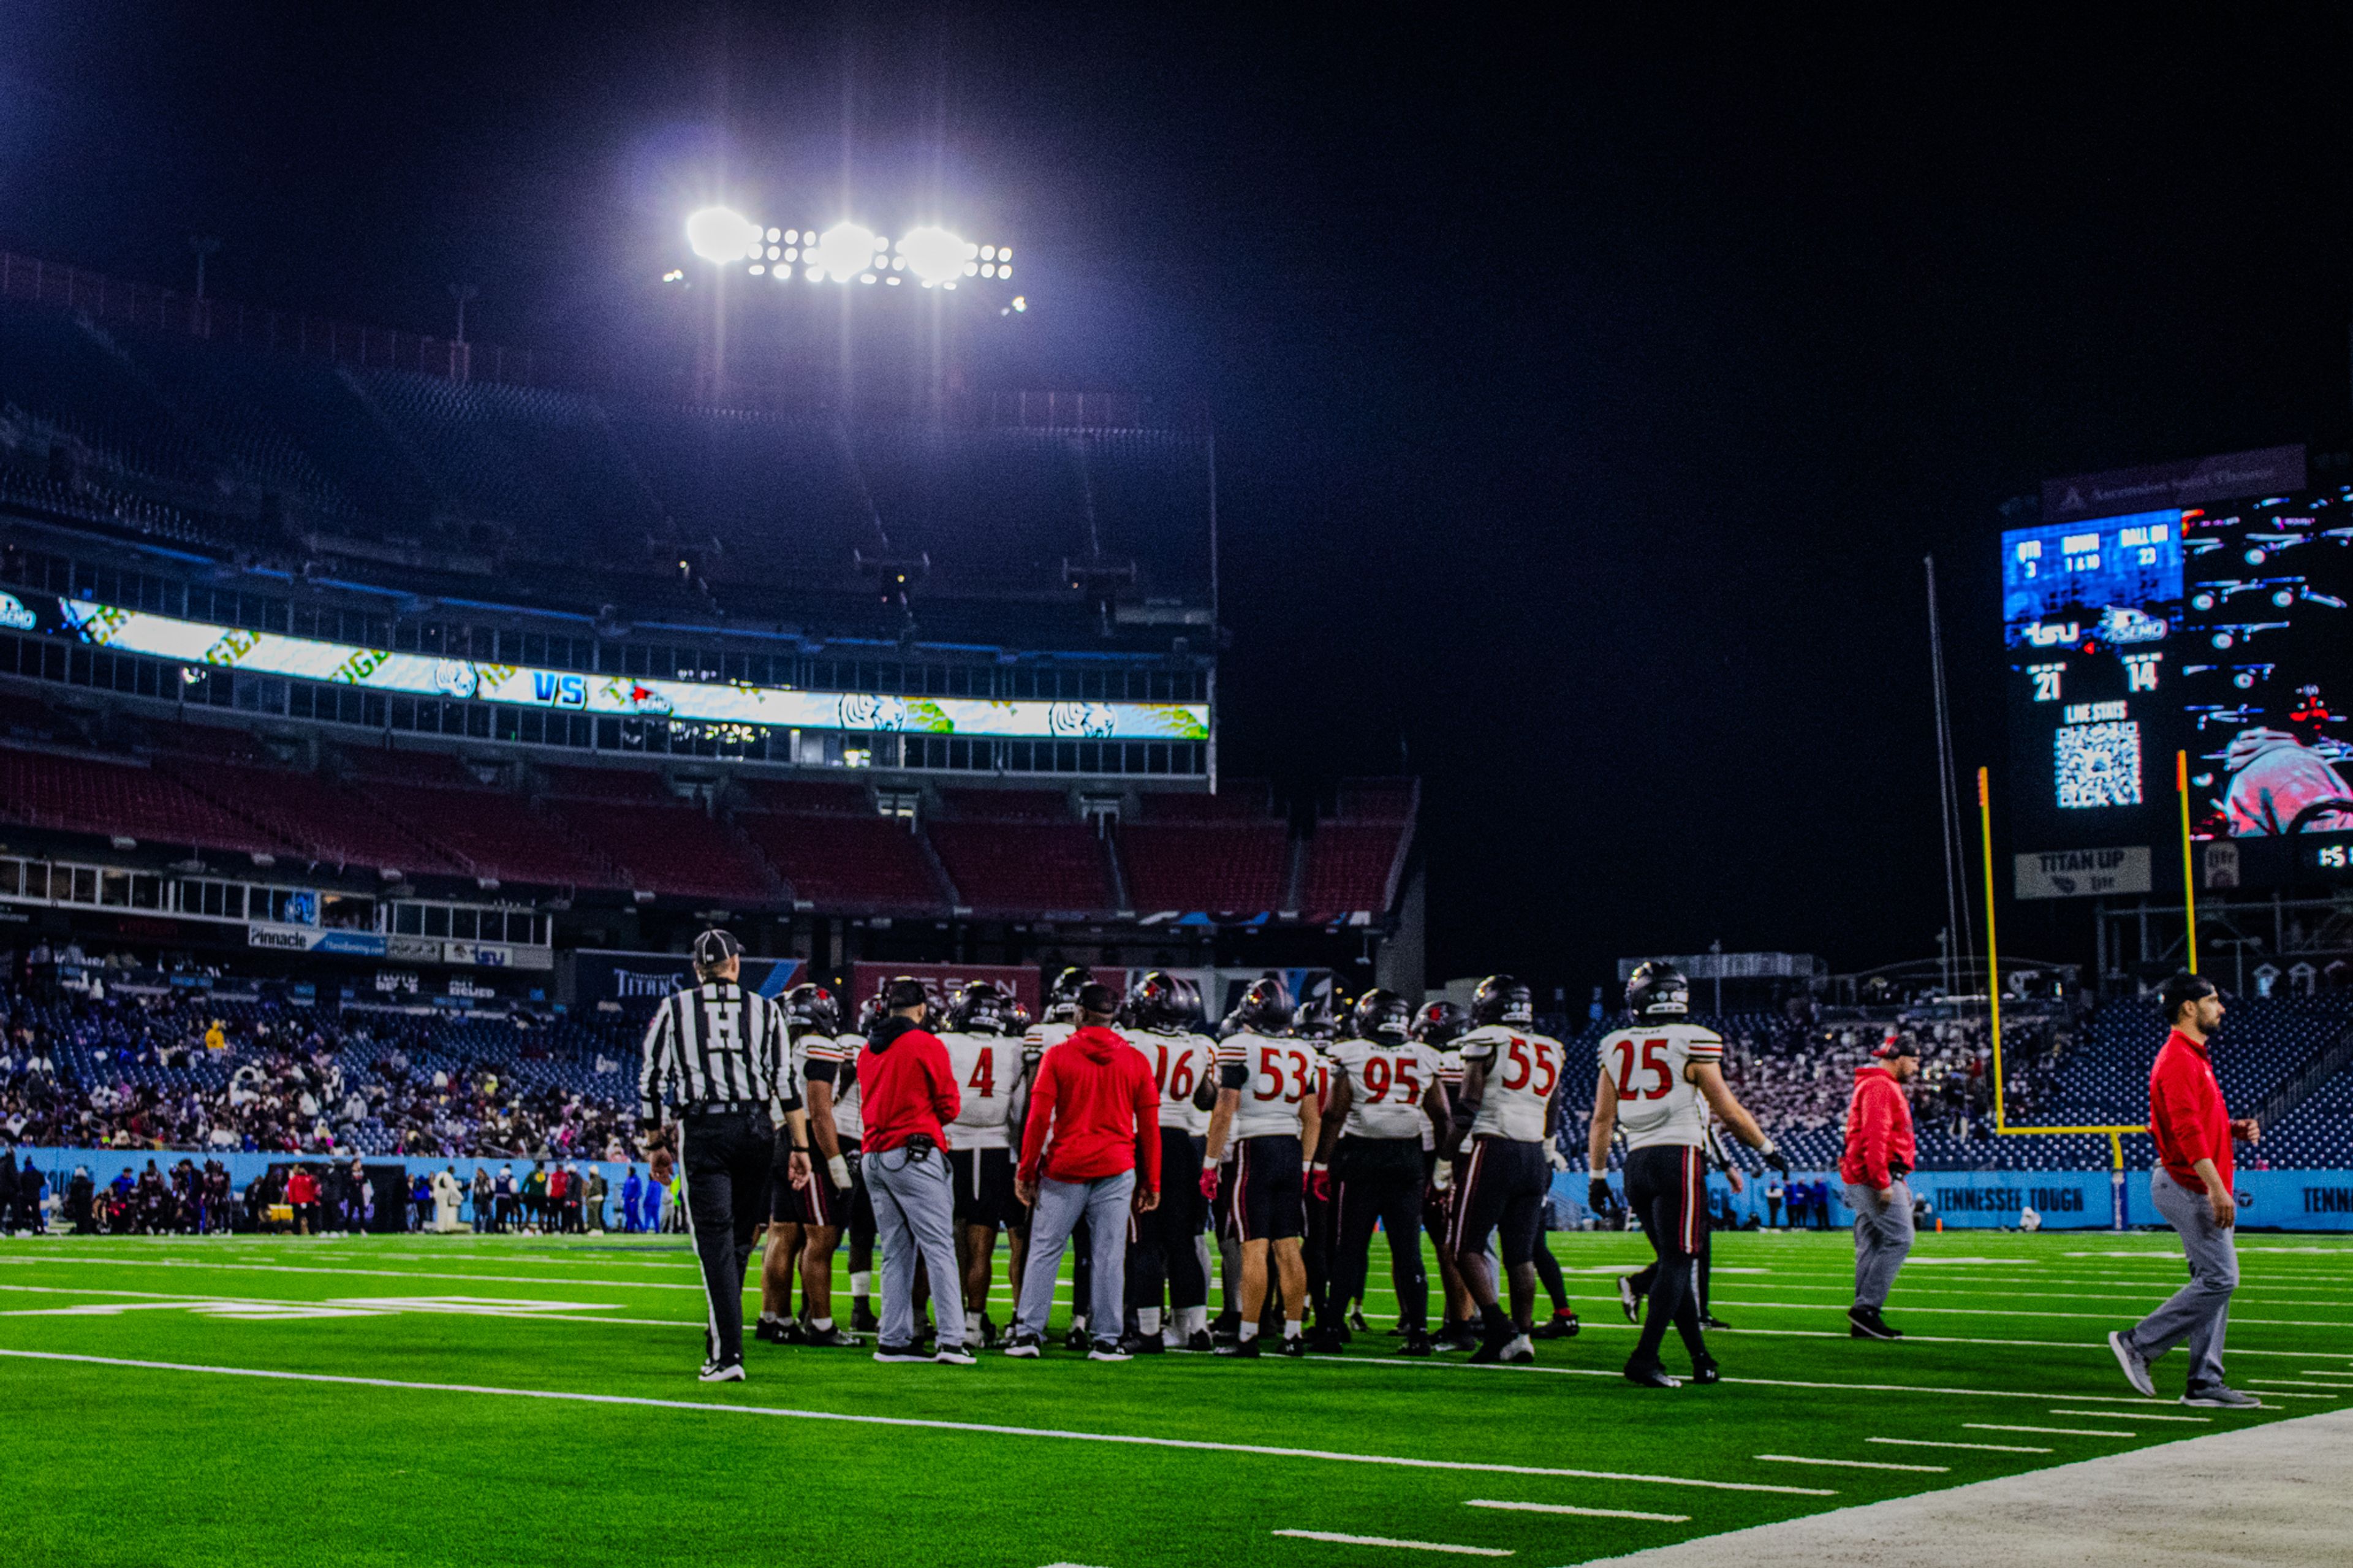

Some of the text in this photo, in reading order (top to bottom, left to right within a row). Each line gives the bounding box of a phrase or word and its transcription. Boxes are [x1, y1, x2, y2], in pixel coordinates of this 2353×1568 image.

[532, 671, 586, 710] VS
[2033, 671, 2061, 702] 21
[2128, 662, 2157, 692] 14
[2039, 849, 2124, 873] TITAN UP
[252, 926, 306, 947] Pinnacle
[704, 1001, 743, 1050] H
[968, 1047, 994, 1097] 4
[1156, 1045, 1194, 1102] 16
[1254, 1047, 1308, 1104] 53
[1363, 1057, 1420, 1104] 95
[1502, 1035, 1556, 1097] 55
[1613, 1039, 1673, 1100] 25
[1936, 1187, 2083, 1212] TENNESSEE TOUGH
[2303, 1187, 2353, 1212] TENN
